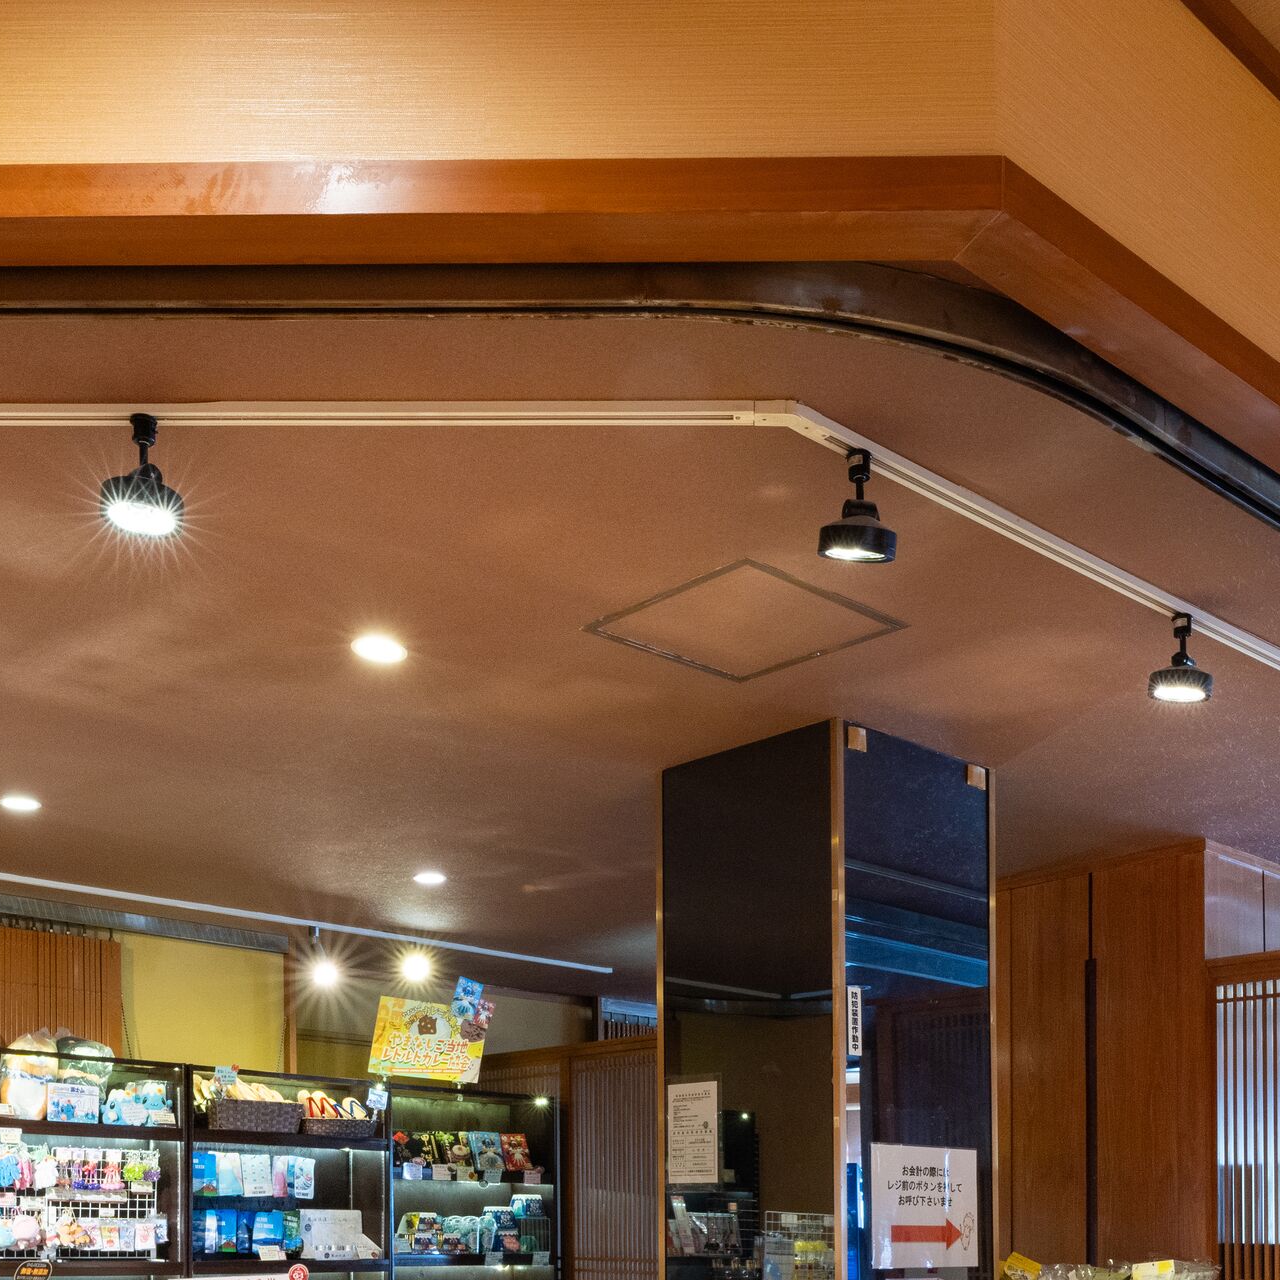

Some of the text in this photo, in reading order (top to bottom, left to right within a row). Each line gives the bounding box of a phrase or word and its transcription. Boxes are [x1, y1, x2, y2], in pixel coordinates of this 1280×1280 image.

[851, 990, 859, 1051] 防犯装置作動中
